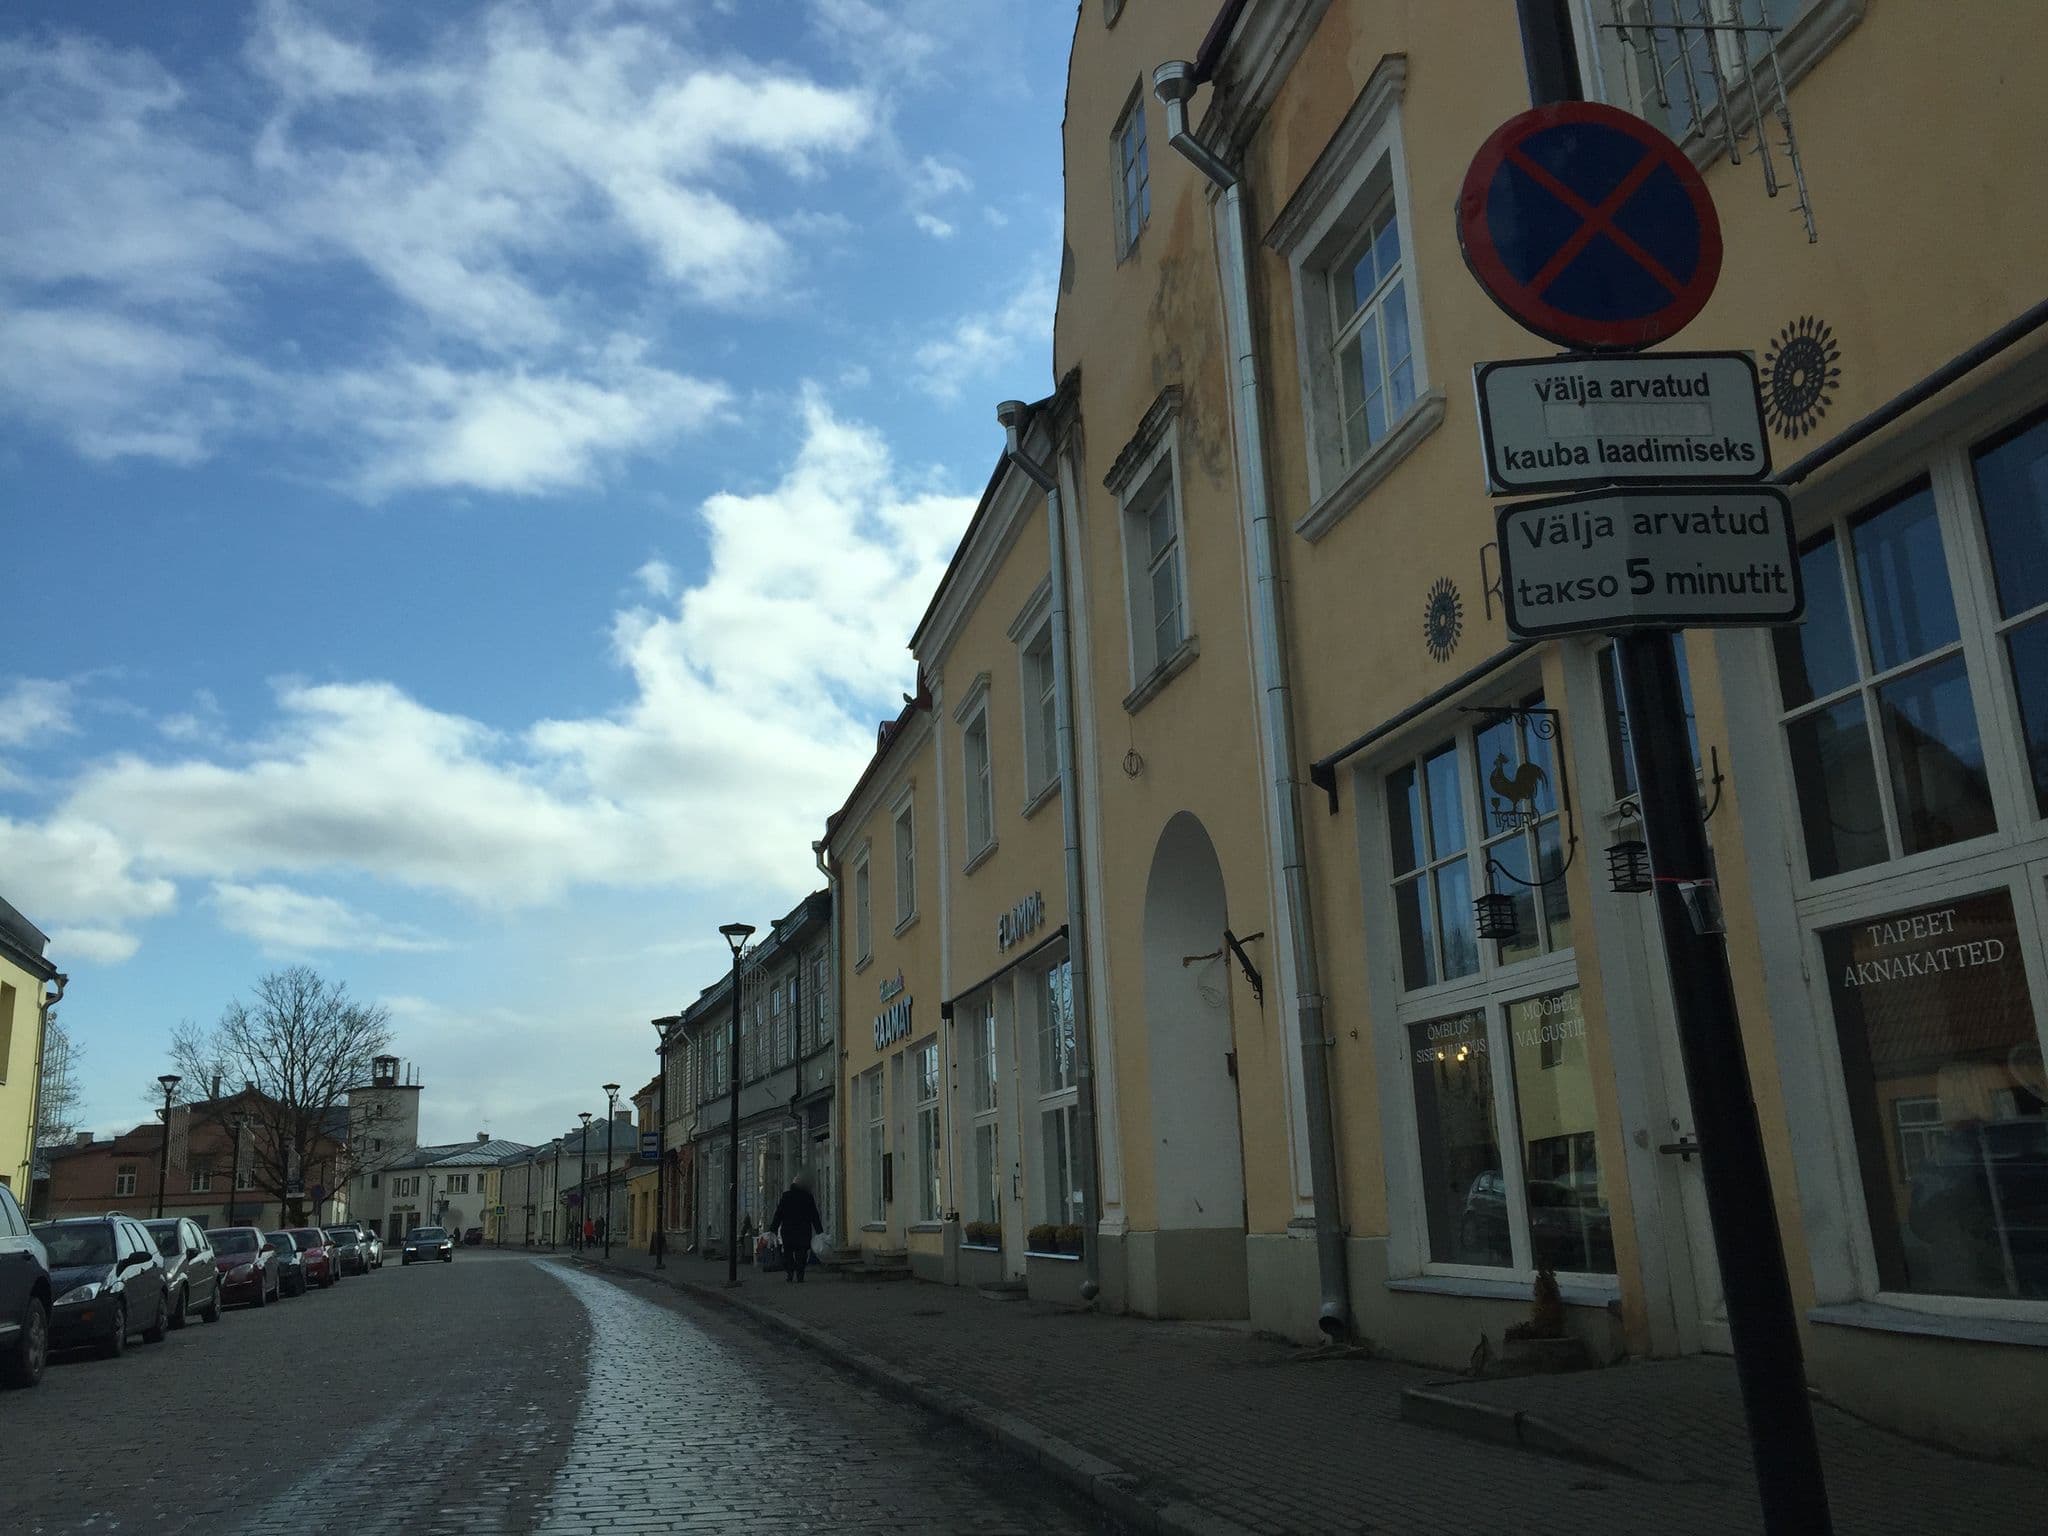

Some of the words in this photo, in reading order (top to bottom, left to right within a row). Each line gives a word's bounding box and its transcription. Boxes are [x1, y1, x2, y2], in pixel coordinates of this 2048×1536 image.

[1610, 372, 1710, 399] arvatud
[1504, 441, 1589, 471] kauba
[1597, 437, 1755, 464] laadimiseks
[1520, 509, 1614, 549] Välja
[1633, 505, 1770, 536] arvatud
[1518, 573, 1619, 608] takso
[1626, 558, 1655, 595] 5
[1666, 562, 1788, 595] minutit
[1866, 909, 1956, 947] TAPEET
[1843, 938, 2006, 988] AKNAKATTED
